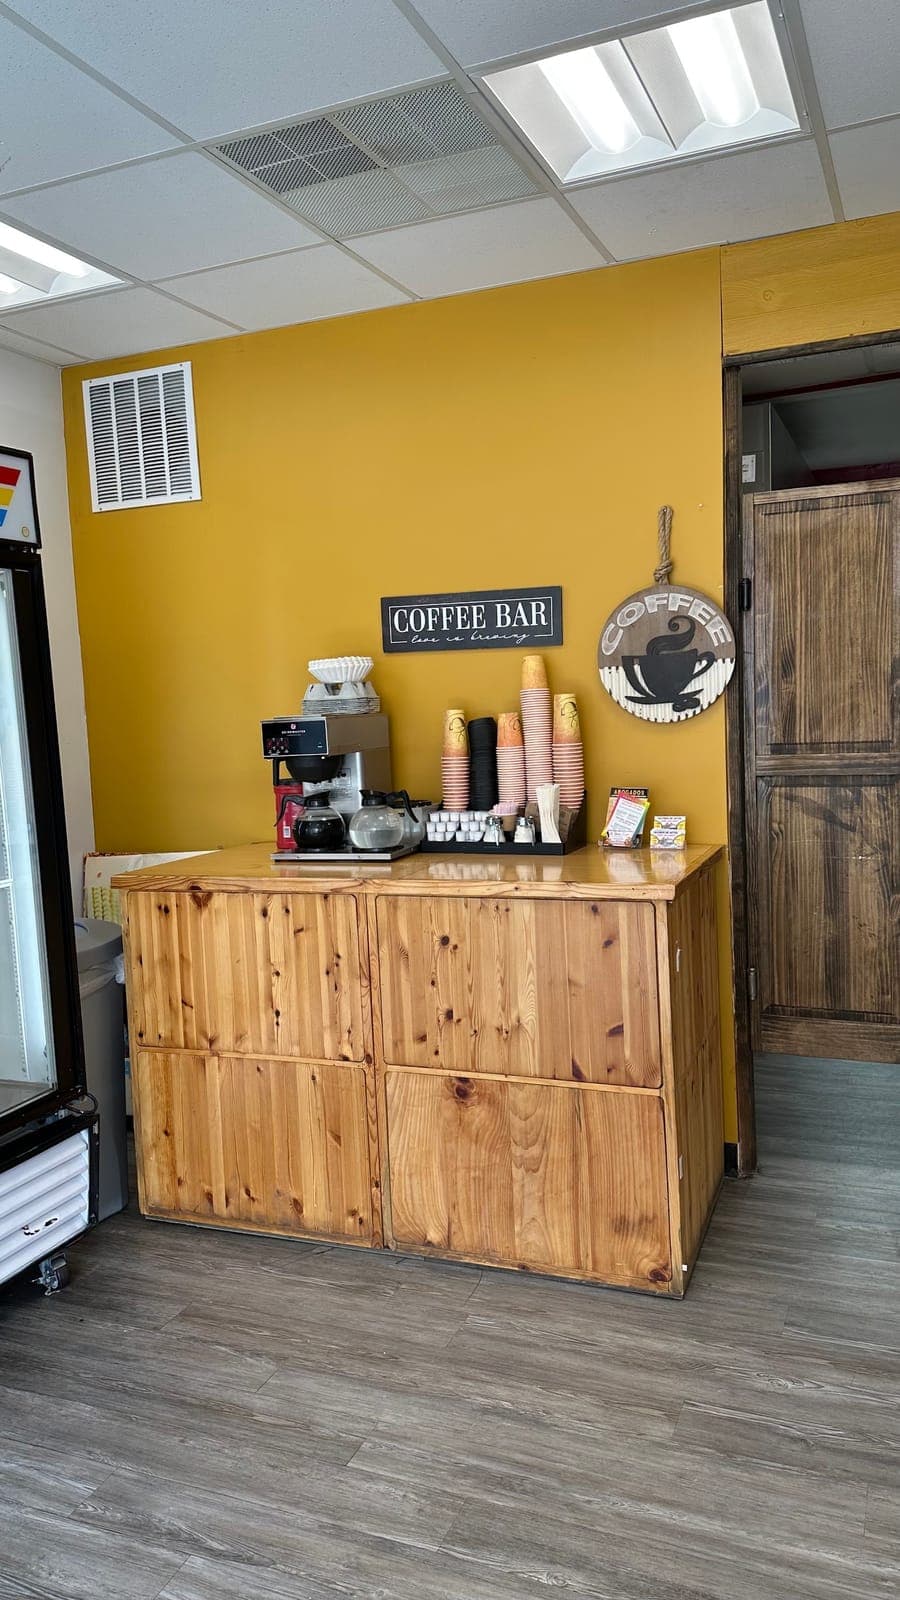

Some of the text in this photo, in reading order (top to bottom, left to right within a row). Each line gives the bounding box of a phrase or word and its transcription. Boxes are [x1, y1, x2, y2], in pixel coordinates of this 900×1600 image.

[393, 601, 549, 633] COFFEE BAR
[601, 592, 732, 656] COFFEE
